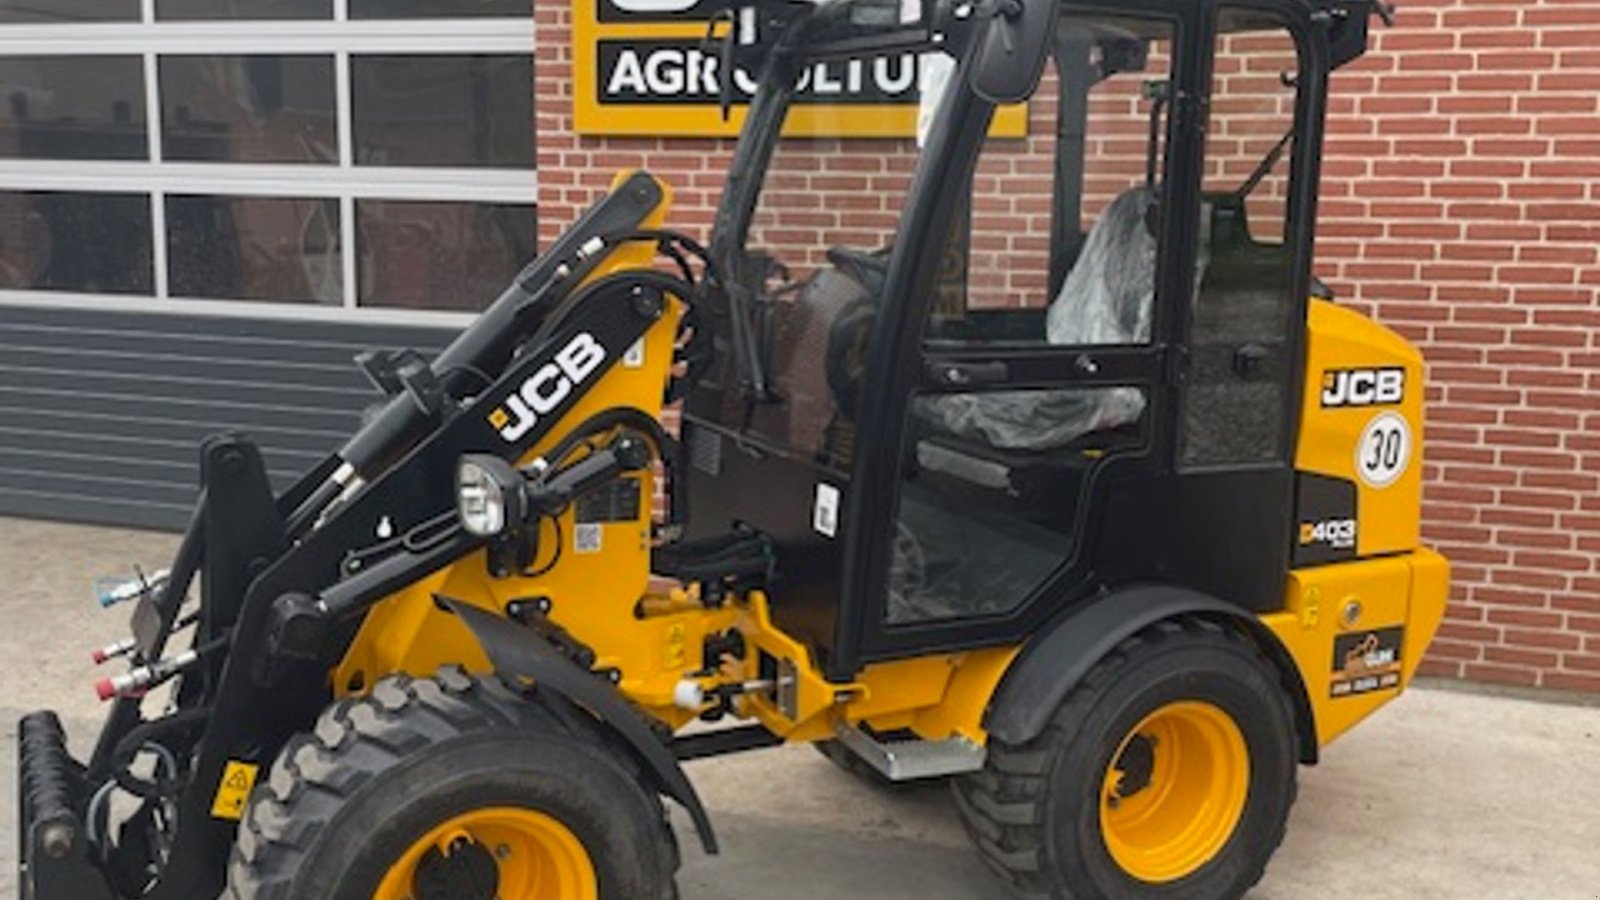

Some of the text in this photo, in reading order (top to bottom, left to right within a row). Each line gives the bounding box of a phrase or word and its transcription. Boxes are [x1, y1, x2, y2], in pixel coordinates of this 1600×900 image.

[489, 332, 606, 441] JCB
[1321, 369, 1403, 406] JCB
[1366, 429, 1401, 470] 30
